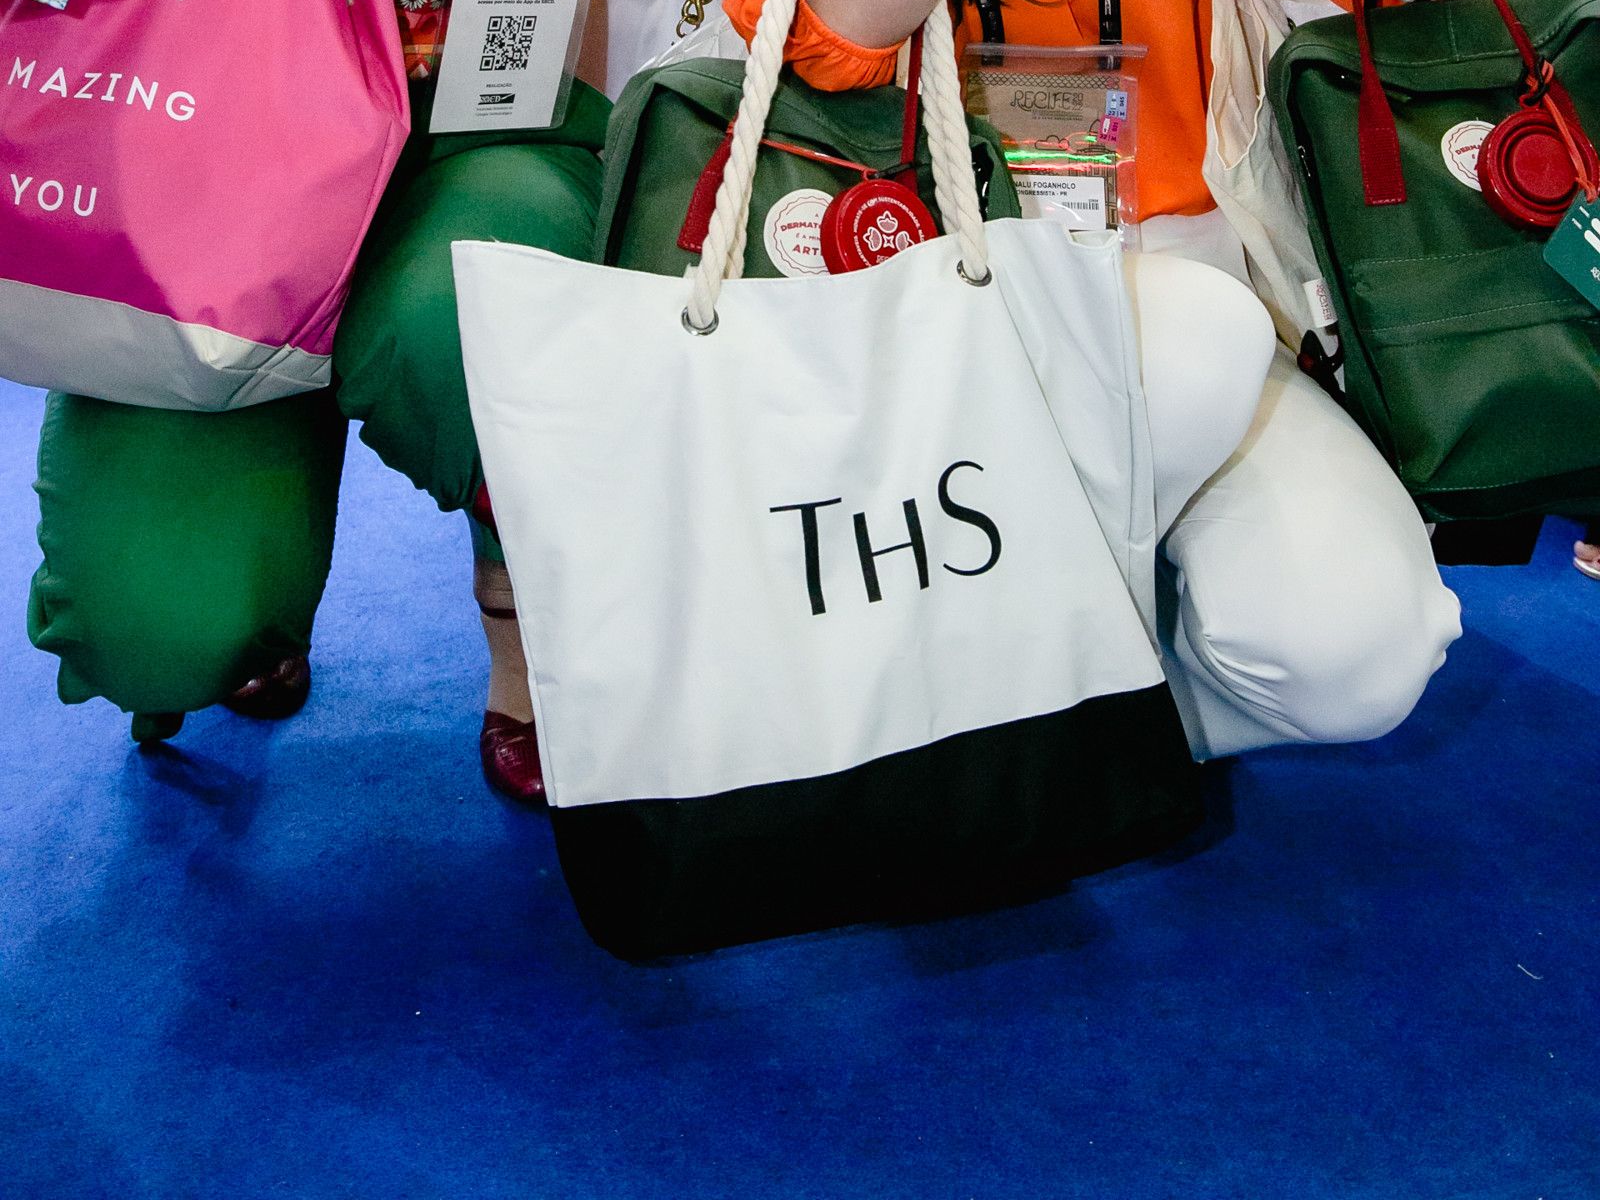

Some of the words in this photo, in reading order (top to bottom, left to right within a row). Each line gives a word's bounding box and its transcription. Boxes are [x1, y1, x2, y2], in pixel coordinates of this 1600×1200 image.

[8, 57, 196, 121] MAZING
[10, 173, 97, 217] YOU
[1033, 181, 1077, 190] FOGANHOLO
[780, 221, 821, 232] DERMAT
[769, 460, 1002, 615] THS
